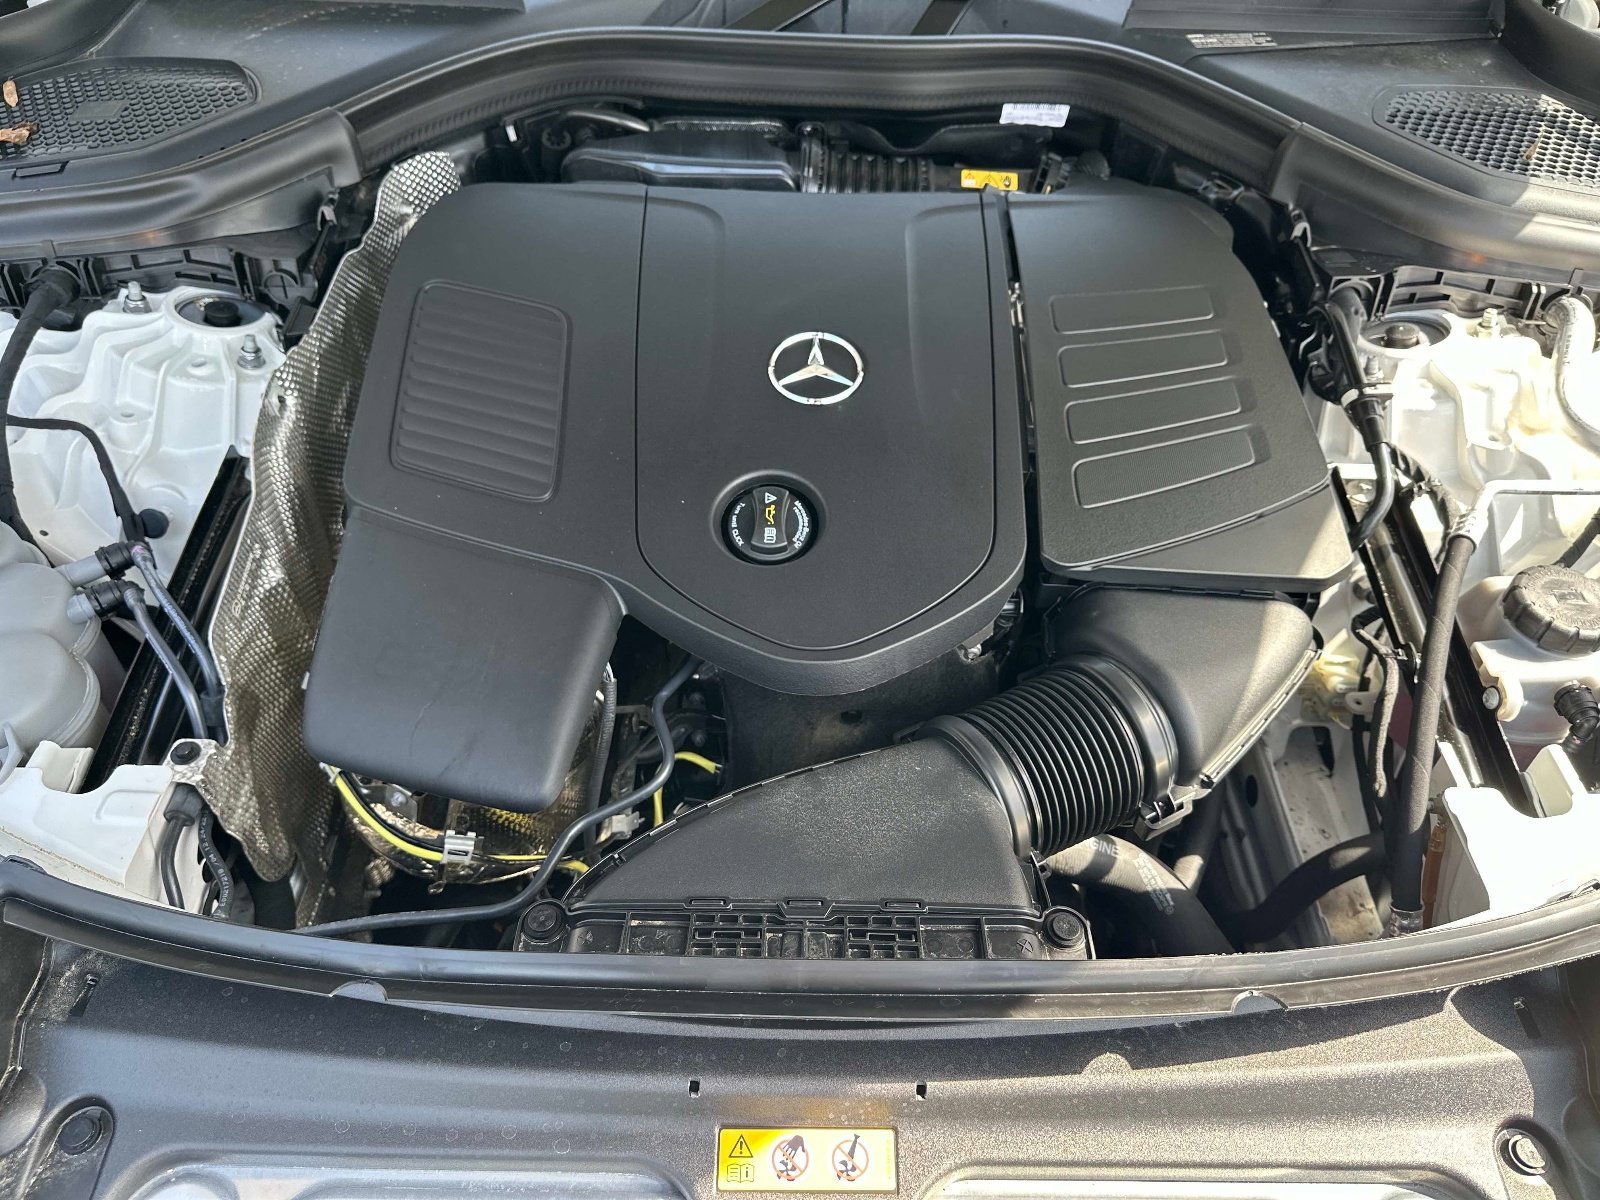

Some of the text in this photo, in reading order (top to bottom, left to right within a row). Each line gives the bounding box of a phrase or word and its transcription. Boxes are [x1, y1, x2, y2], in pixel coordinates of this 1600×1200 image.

[734, 502, 746, 514] Turn
[732, 528, 745, 547] CLICK
[1089, 838, 1121, 858] GINE
